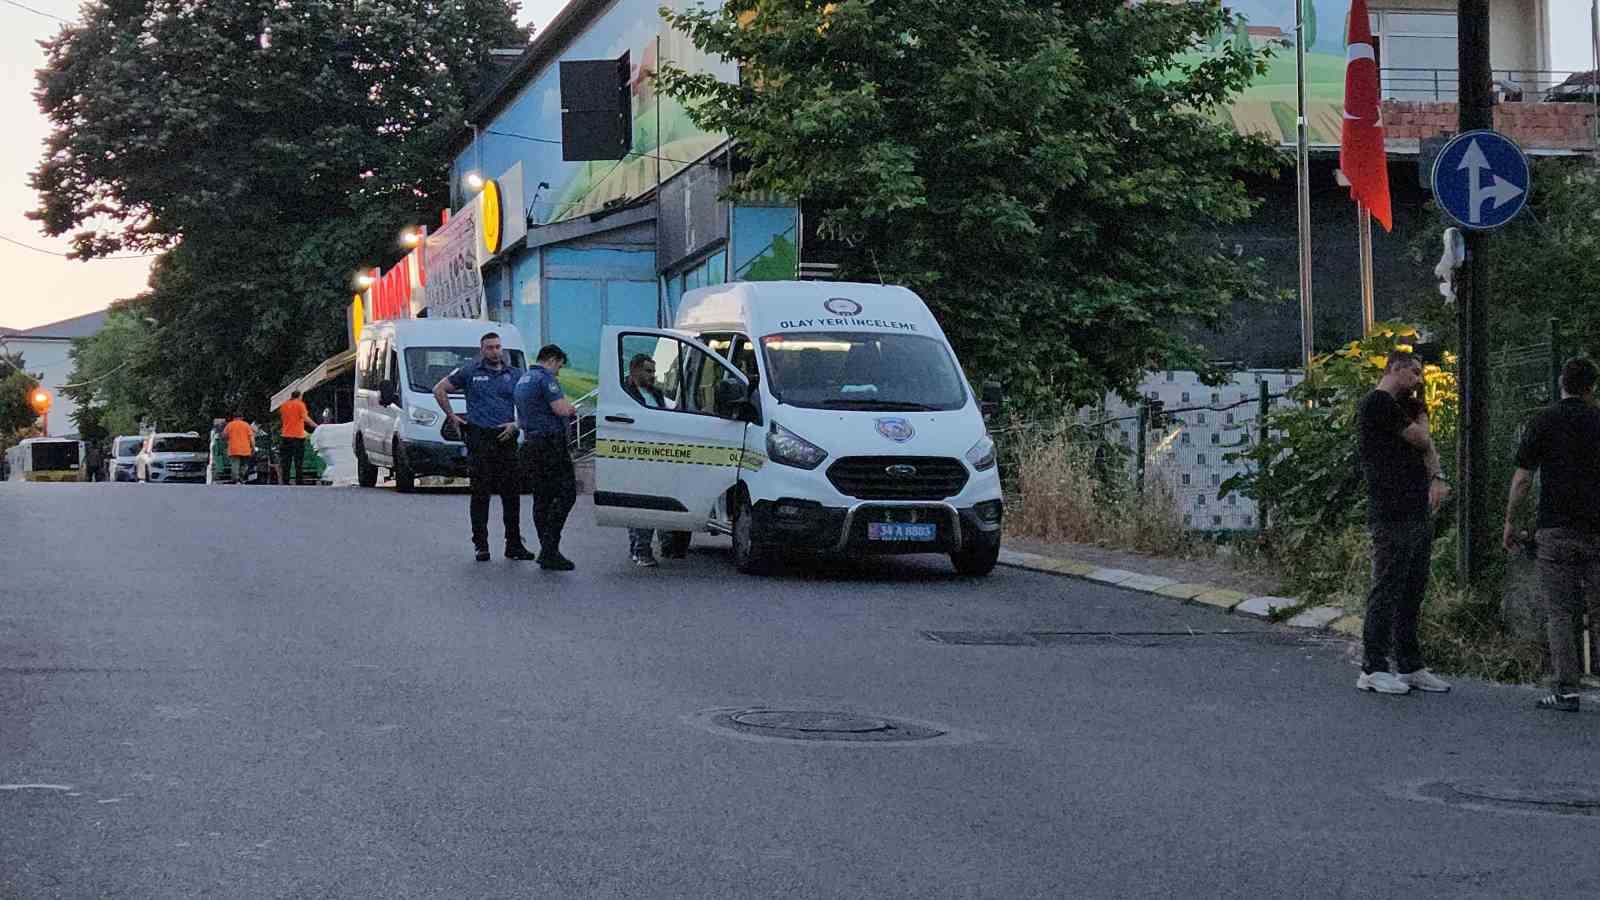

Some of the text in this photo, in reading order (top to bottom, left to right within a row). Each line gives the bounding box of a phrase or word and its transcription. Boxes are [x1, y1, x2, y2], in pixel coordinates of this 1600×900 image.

[780, 317, 918, 331] OLAY YERİ İNCELEME
[611, 445, 631, 455] OLAY
